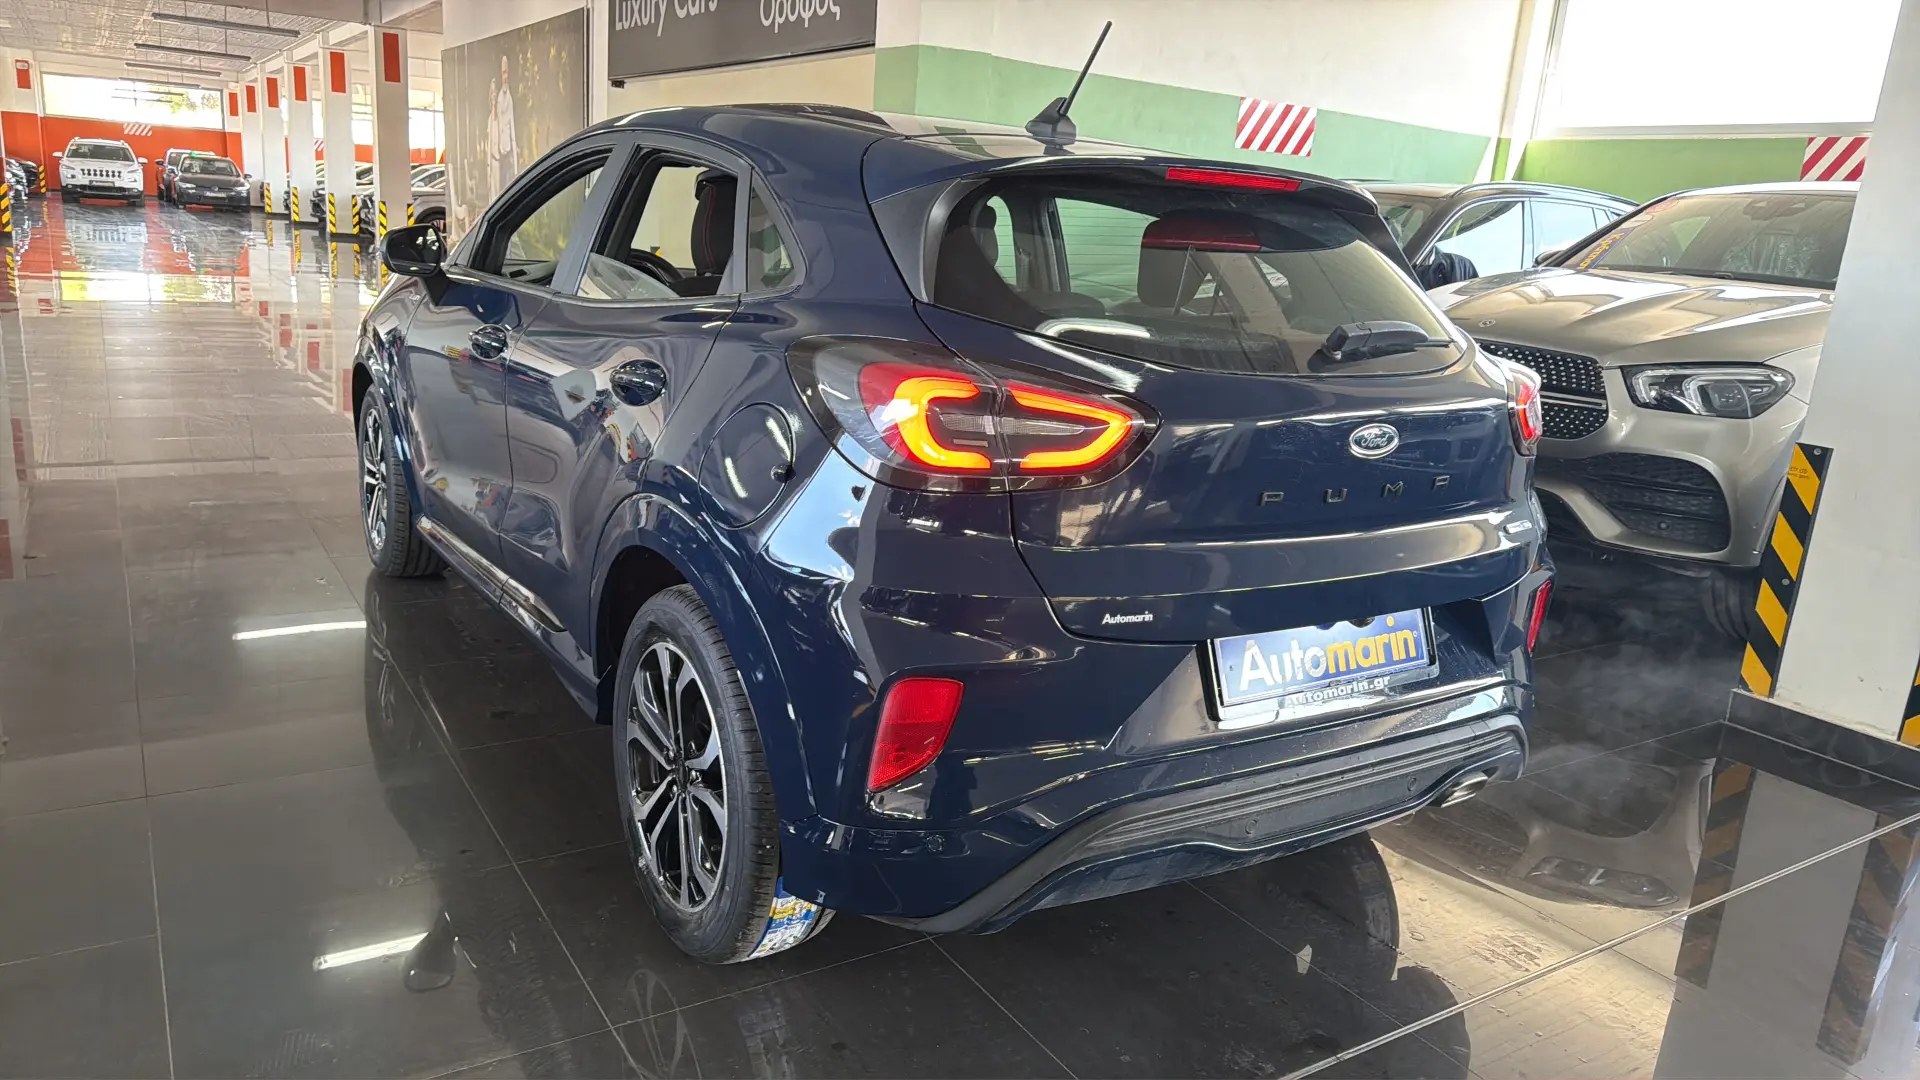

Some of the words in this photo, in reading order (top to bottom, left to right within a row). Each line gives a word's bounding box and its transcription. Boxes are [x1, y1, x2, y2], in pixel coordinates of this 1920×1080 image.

[615, 0, 667, 37] Luxury
[1259, 474, 1450, 507] PUMA
[1102, 610, 1154, 625] Automarin
[1239, 616, 1417, 691] Automarin
